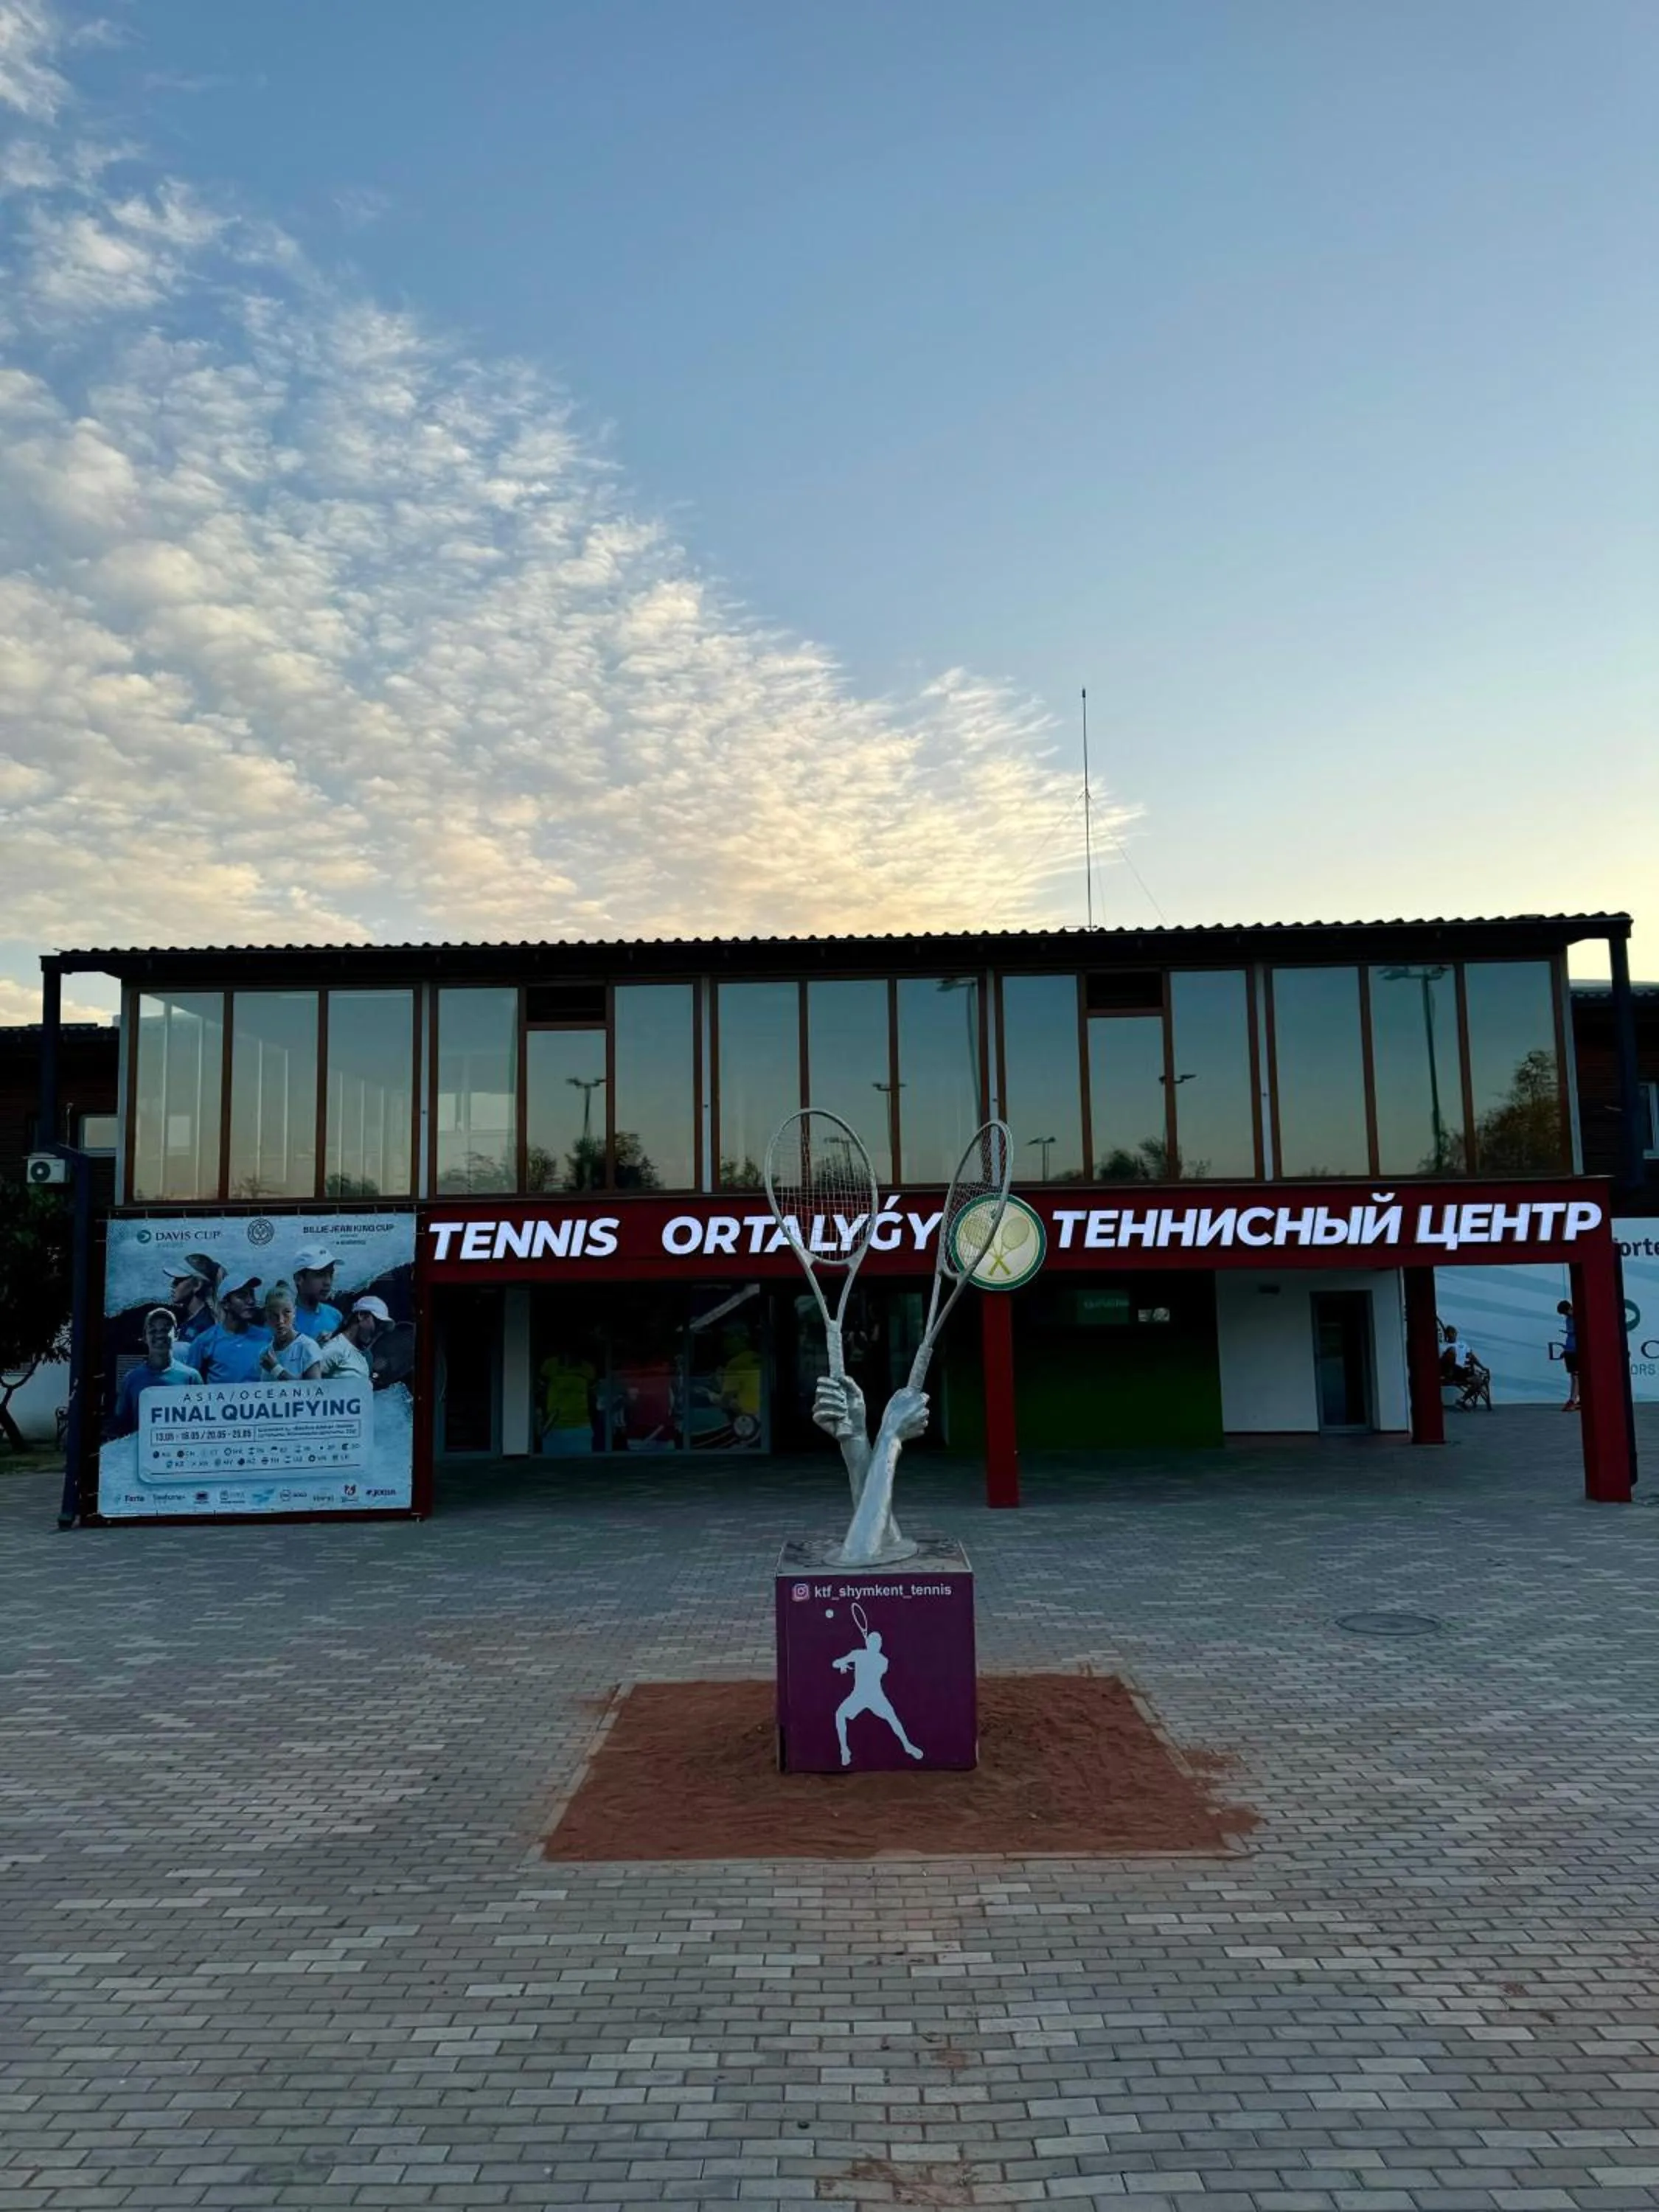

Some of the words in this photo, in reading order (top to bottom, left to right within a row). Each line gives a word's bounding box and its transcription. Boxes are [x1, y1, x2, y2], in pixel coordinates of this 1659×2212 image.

[1052, 1192, 1402, 1248] ТЕННИСНЫЙ
[1416, 1202, 1602, 1250] ЦЕНТР
[156, 1231, 191, 1241] DAVIS
[195, 1231, 220, 1239] CUP
[430, 1217, 621, 1260] TENNIS
[150, 1405, 216, 1424] FINAL
[221, 1398, 361, 1421] QUALIFYING
[815, 1583, 952, 1601] ktf_shymkent_tennis
